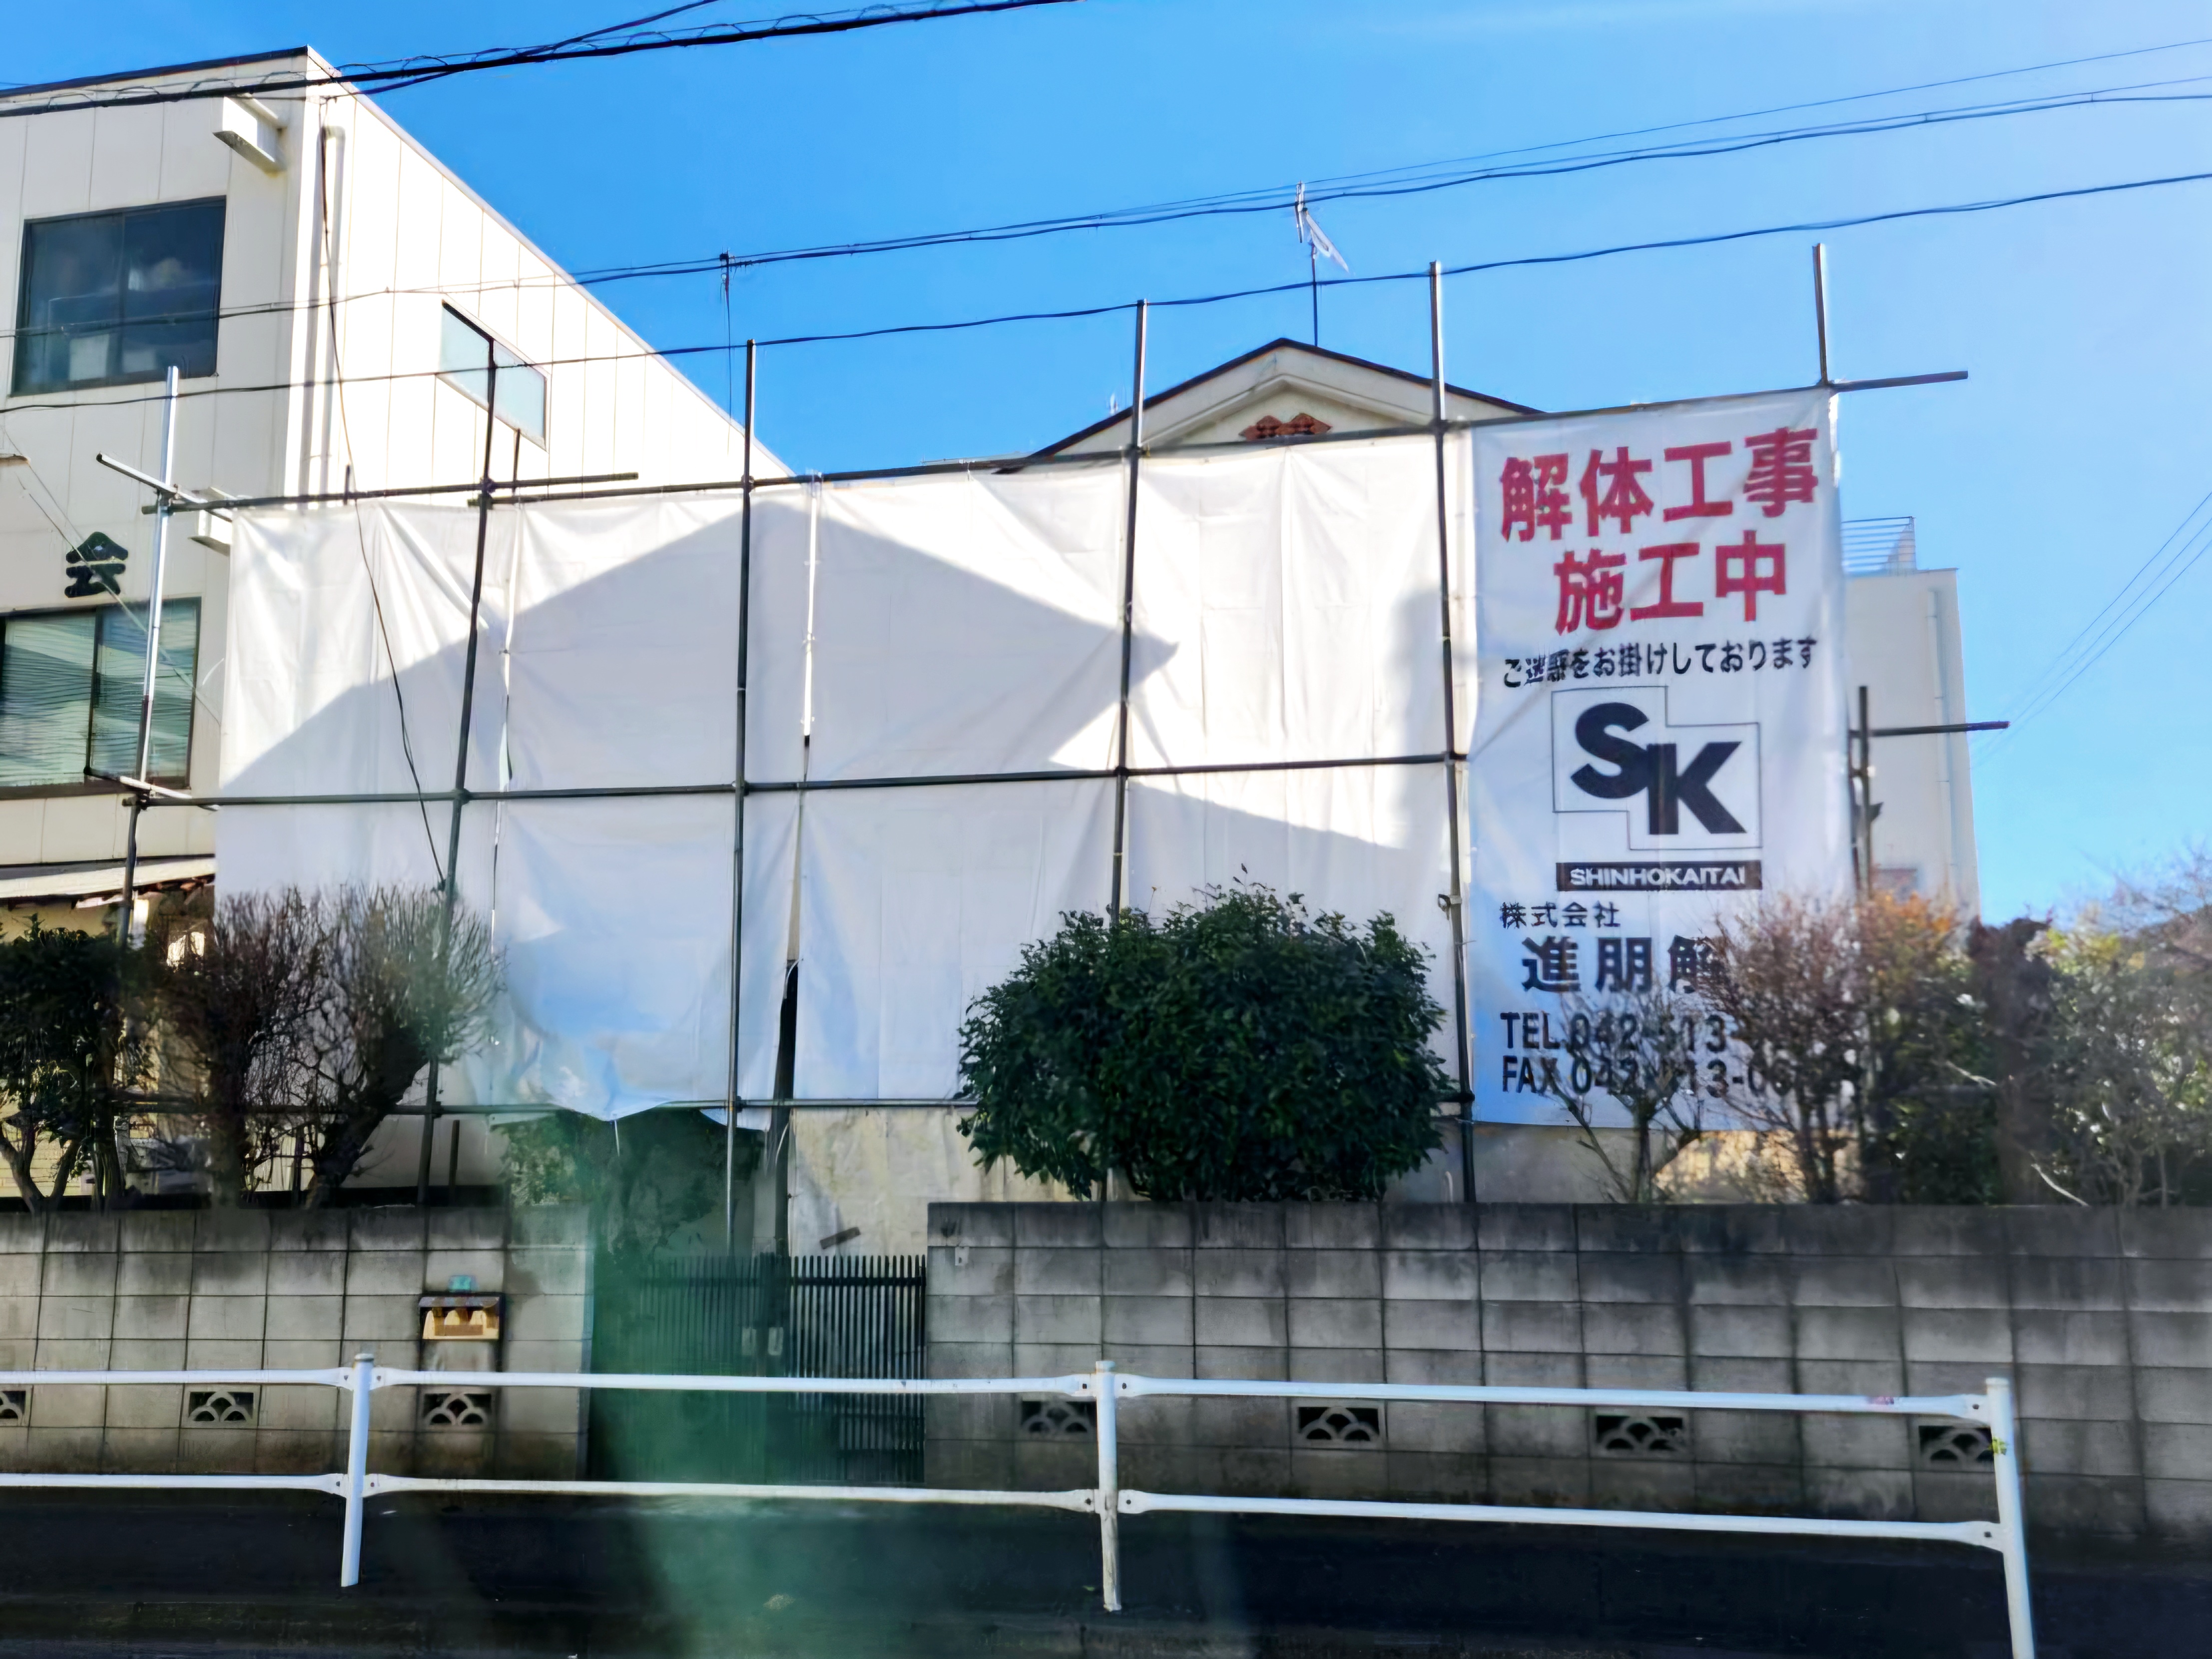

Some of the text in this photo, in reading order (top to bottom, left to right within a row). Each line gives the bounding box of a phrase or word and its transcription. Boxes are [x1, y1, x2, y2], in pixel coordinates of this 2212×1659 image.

[1500, 426, 1819, 543] 解体工事
[1554, 529, 1786, 636] 施工中
[1570, 702, 1747, 835] SK
[1500, 901, 1621, 929] 株式会社
[1570, 866, 1746, 886] SHINHOKAITAI
[1522, 934, 1728, 994] 進朋解
